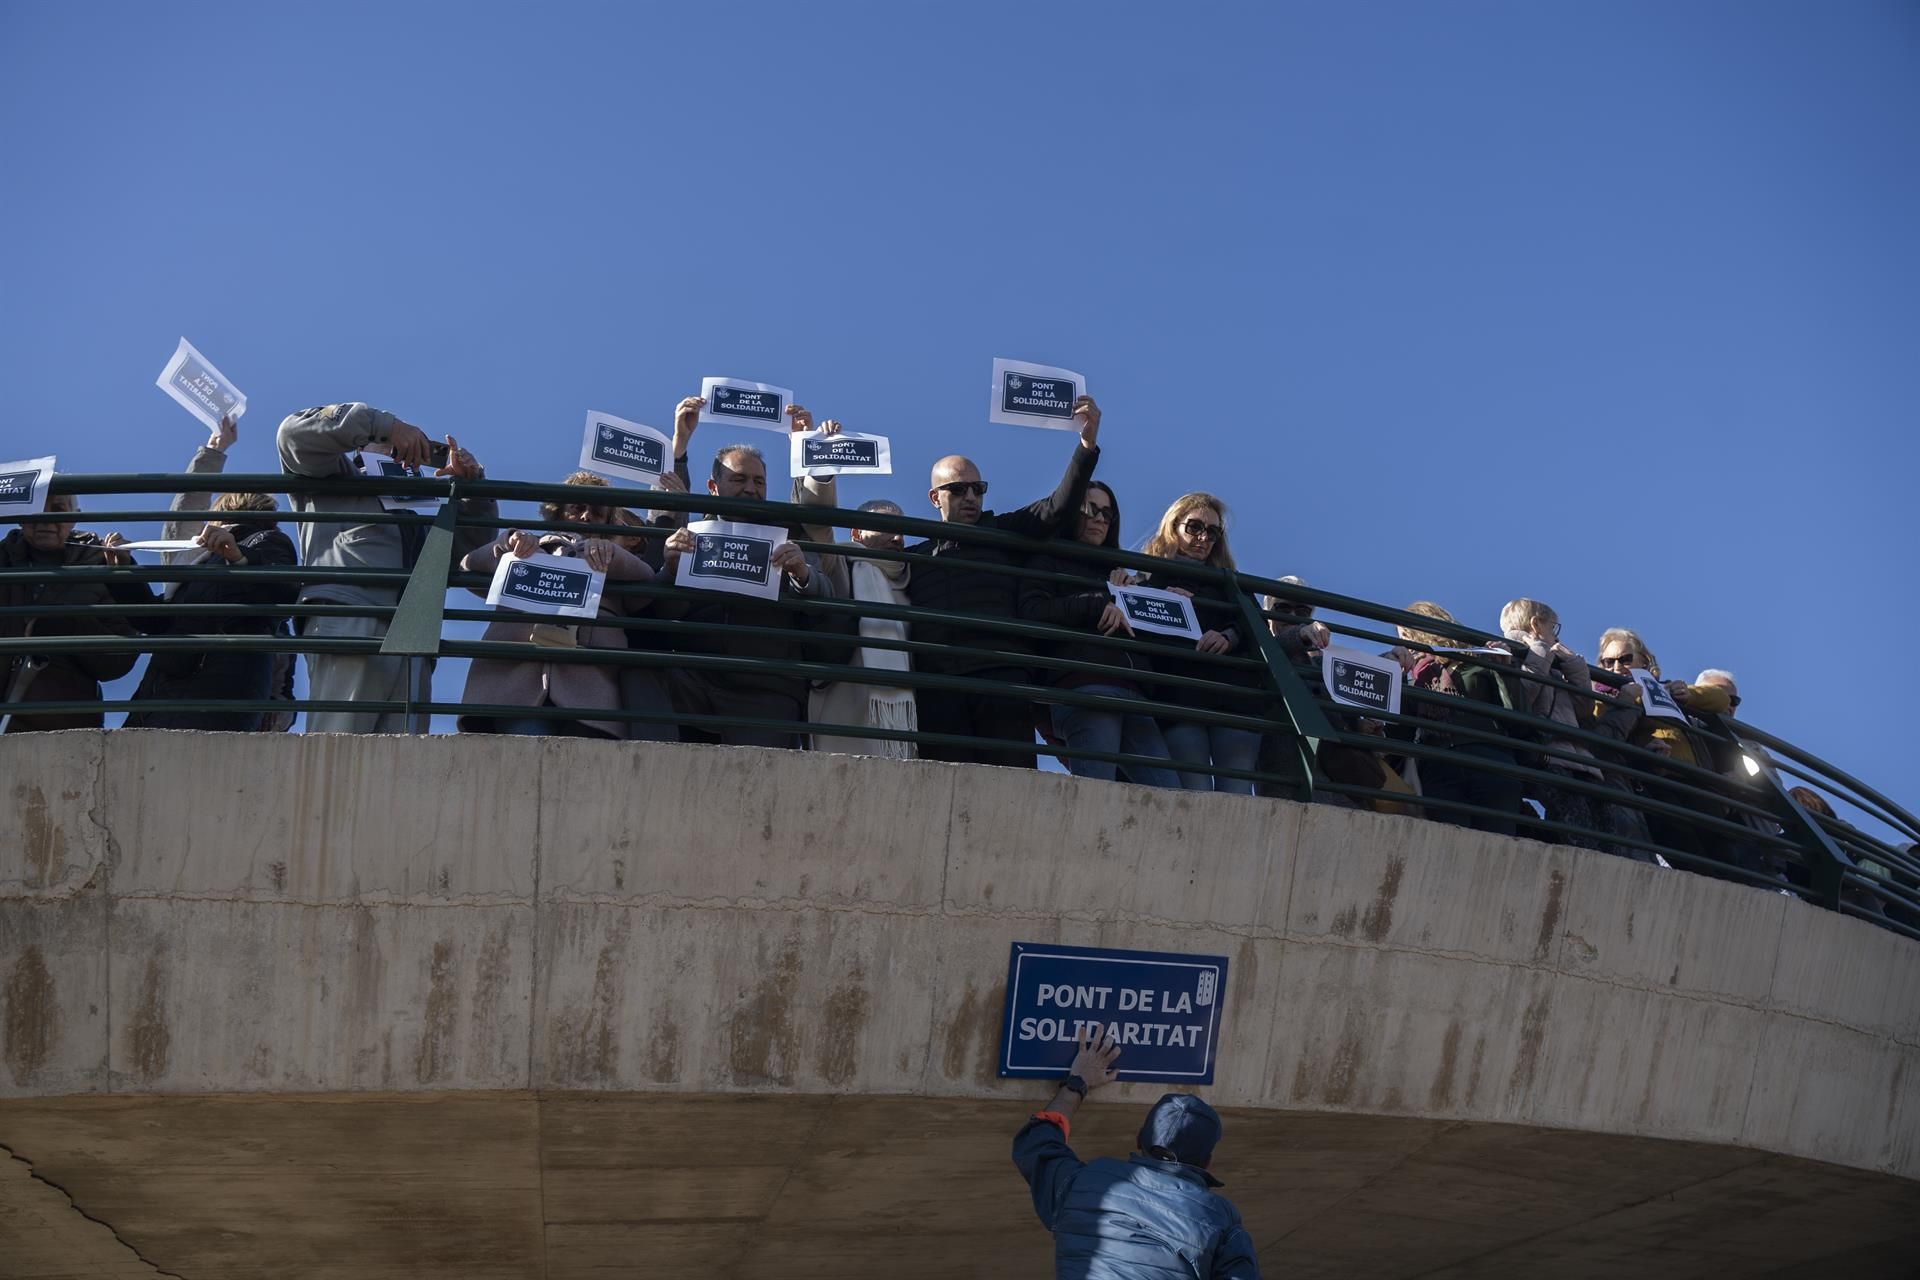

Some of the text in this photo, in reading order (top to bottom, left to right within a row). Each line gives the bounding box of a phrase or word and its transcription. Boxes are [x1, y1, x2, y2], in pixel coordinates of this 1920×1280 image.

[1032, 382, 1055, 390] PONT
[1012, 396, 1069, 409] SOLIDARITAT
[720, 403, 775, 413] SOLIDARITAT
[623, 436, 646, 446] PONT
[622, 443, 633, 451] DE
[603, 446, 658, 465] SOLIDARITAT
[812, 454, 871, 462] SOLIDARITAT
[724, 542, 750, 551] PONT
[723, 551, 748, 561] DE LA
[702, 560, 762, 574] SOLIDARITAT
[540, 572, 566, 581] PONT
[538, 580, 551, 588] DE
[515, 583, 579, 599] SOLIDARITAT
[1146, 600, 1165, 608] PONT
[1134, 610, 1182, 624] SOLIDARITAT
[1355, 670, 1375, 680] PONT
[1354, 679, 1374, 690] DE LA
[1338, 684, 1384, 702] SOLIDARITAT
[1037, 983, 1192, 1014] PONT DE LA
[1019, 1017, 1203, 1048] SOLIDARITAT
